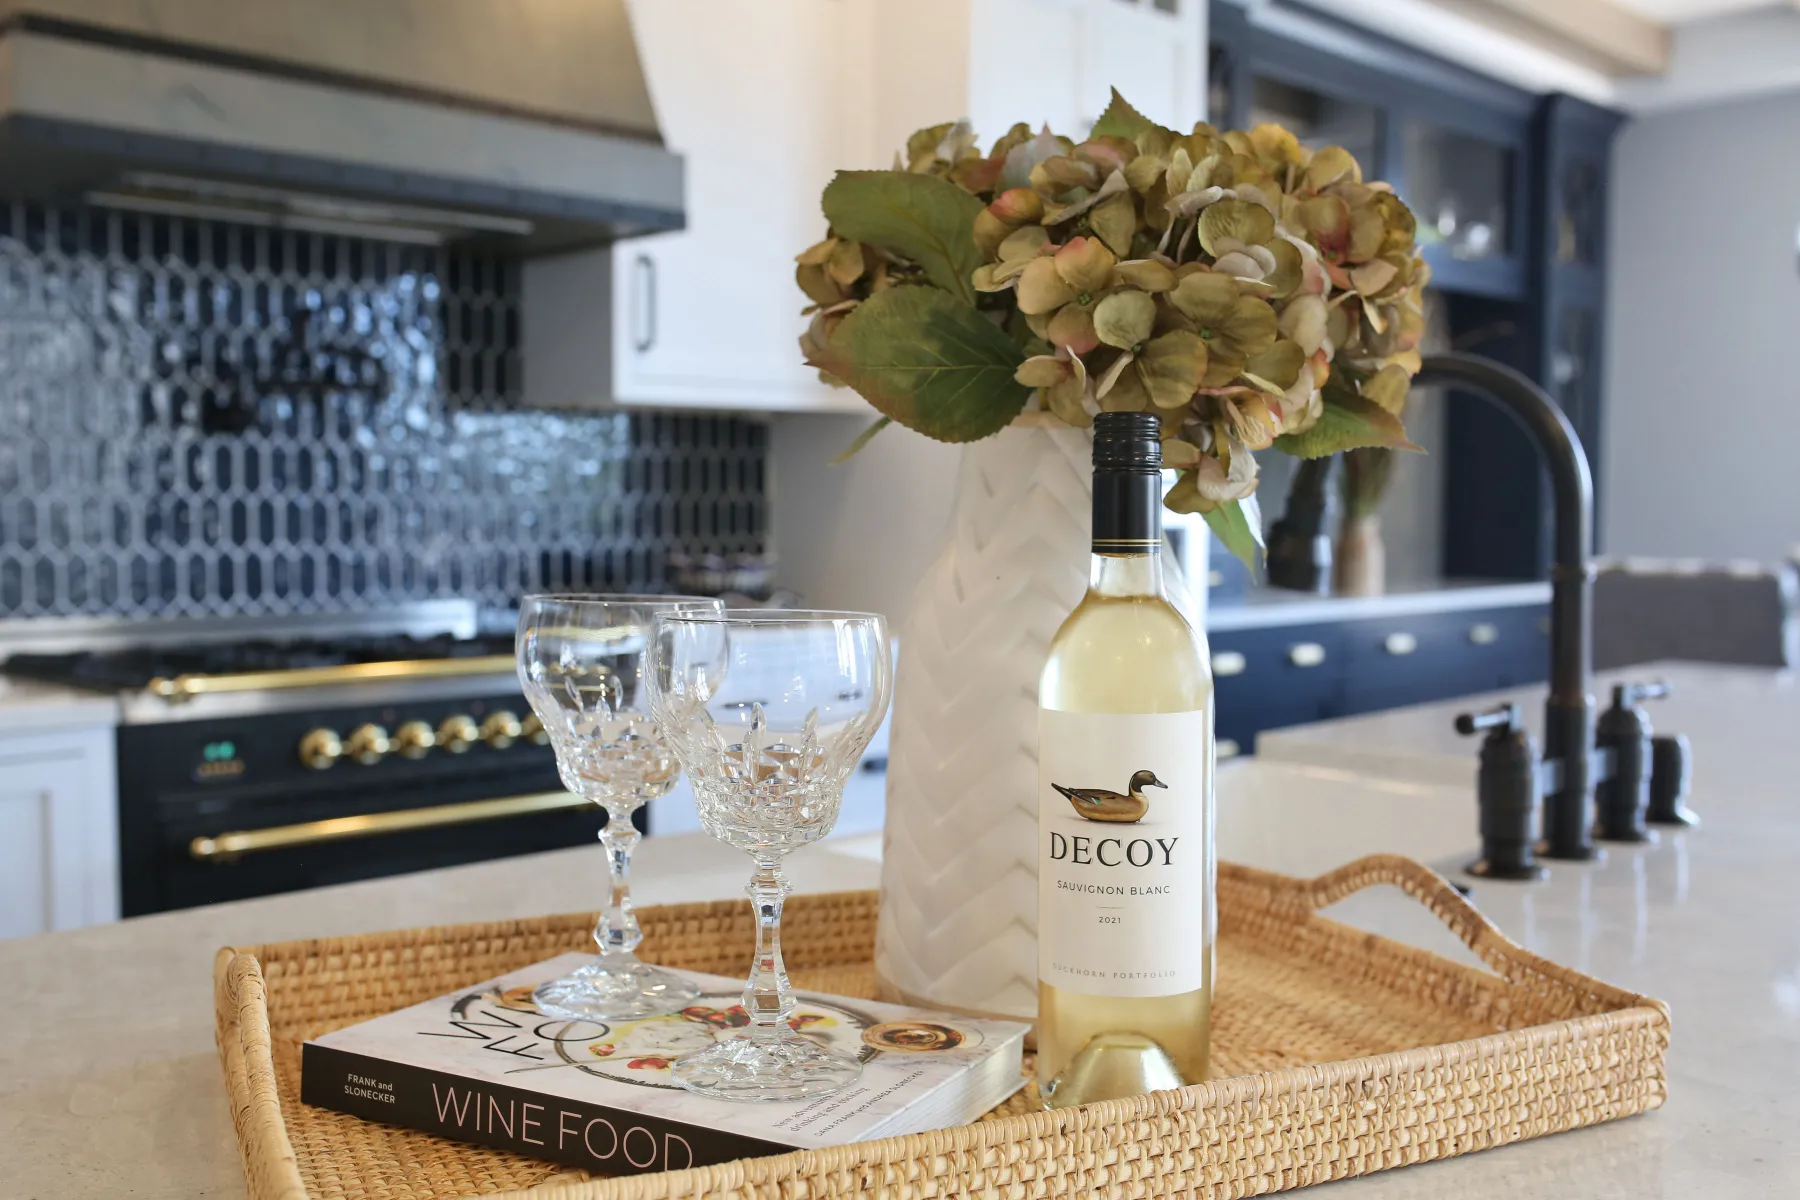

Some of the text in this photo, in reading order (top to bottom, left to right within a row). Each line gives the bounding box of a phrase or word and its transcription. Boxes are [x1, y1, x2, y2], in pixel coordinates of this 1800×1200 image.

[1050, 831, 1180, 868] DECOY
[1057, 880, 1171, 896] SAUVIGNON BLANC
[1098, 916, 1122, 924] 2021
[1052, 962, 1176, 979] DUCKHORN PORTFOLIO
[347, 1073, 393, 1091] FRANK and
[344, 1084, 396, 1105] SLONECKER
[431, 1083, 694, 1172] WINE FOOD
